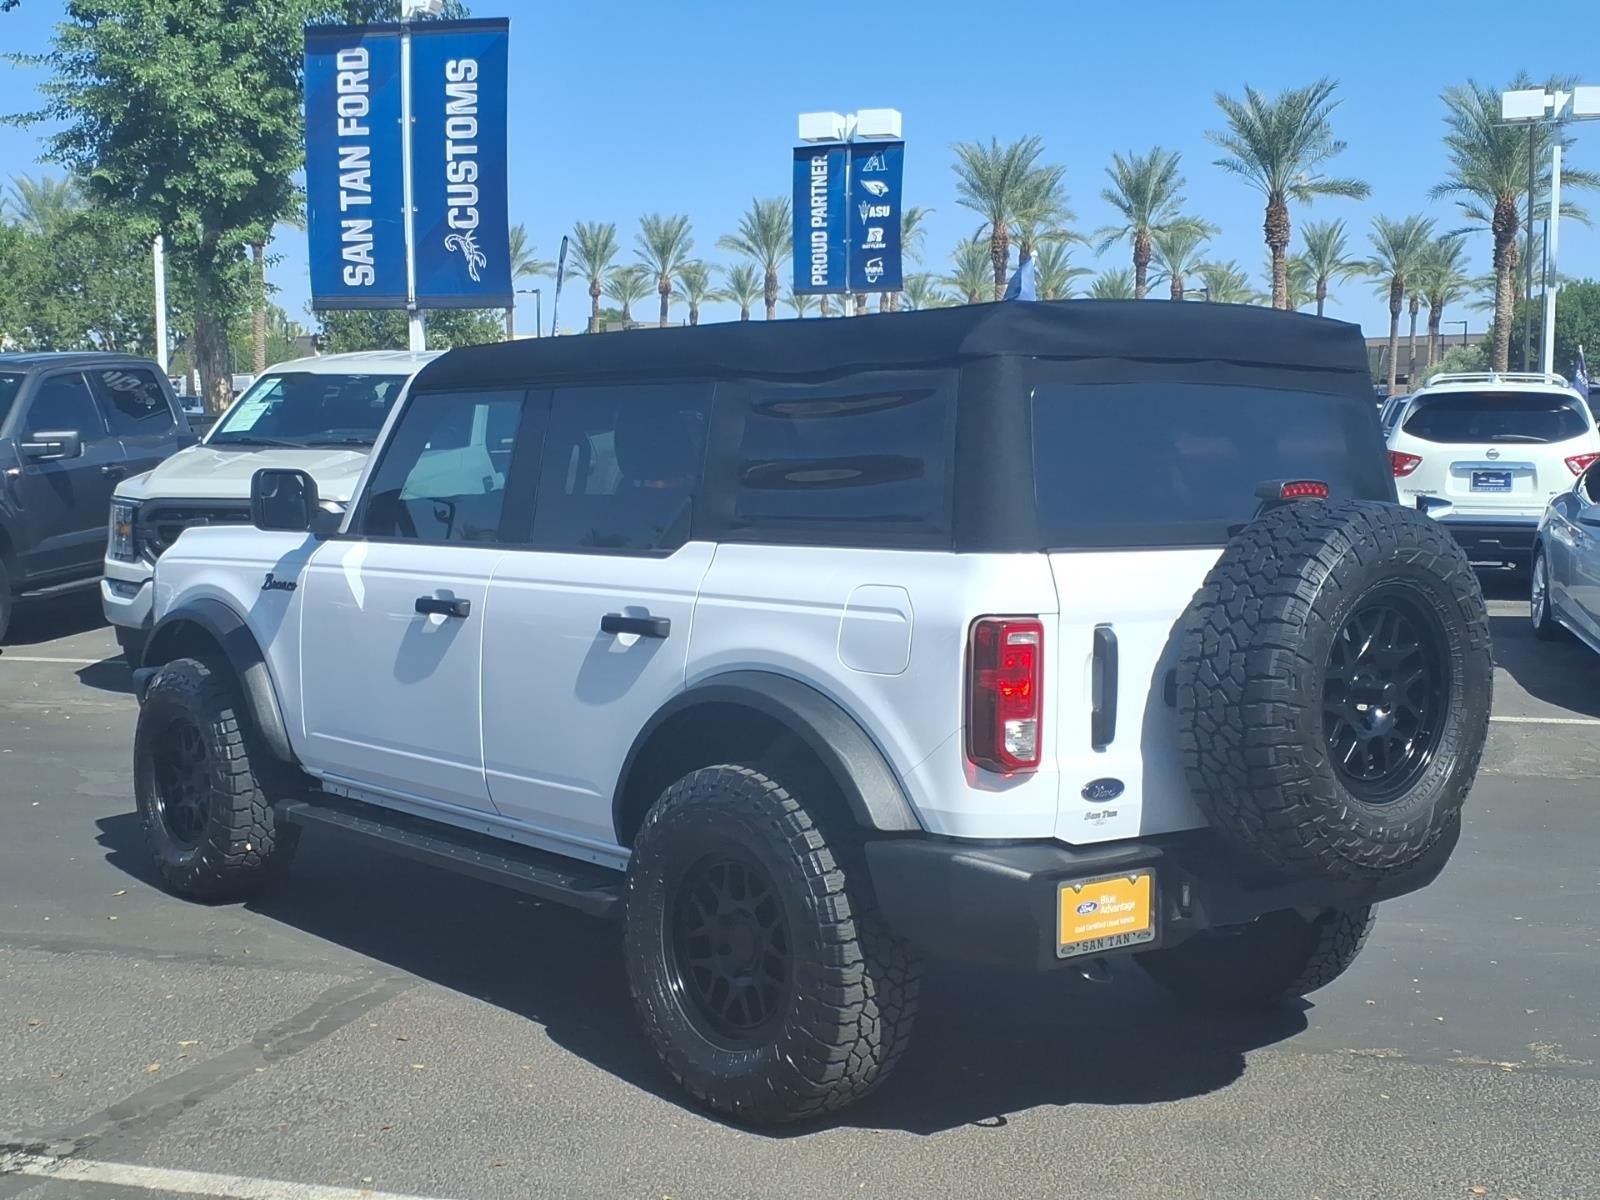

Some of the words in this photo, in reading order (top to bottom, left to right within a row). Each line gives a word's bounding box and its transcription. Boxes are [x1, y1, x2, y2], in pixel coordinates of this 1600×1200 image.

[336, 47, 370, 137] FORD
[445, 58, 479, 230] CUSTOMS
[338, 147, 372, 212] TAN
[811, 155, 828, 228] PARTNER
[869, 205, 890, 218] ASU
[343, 219, 376, 287] SAN
[811, 232, 828, 287] PROUD
[261, 573, 298, 591] Bronco
[1084, 812, 1101, 821] San
[1102, 810, 1118, 819] Tan
[1100, 902, 1135, 913] Advantage
[1082, 938, 1103, 952] SAN
[1108, 934, 1130, 947] TAN
